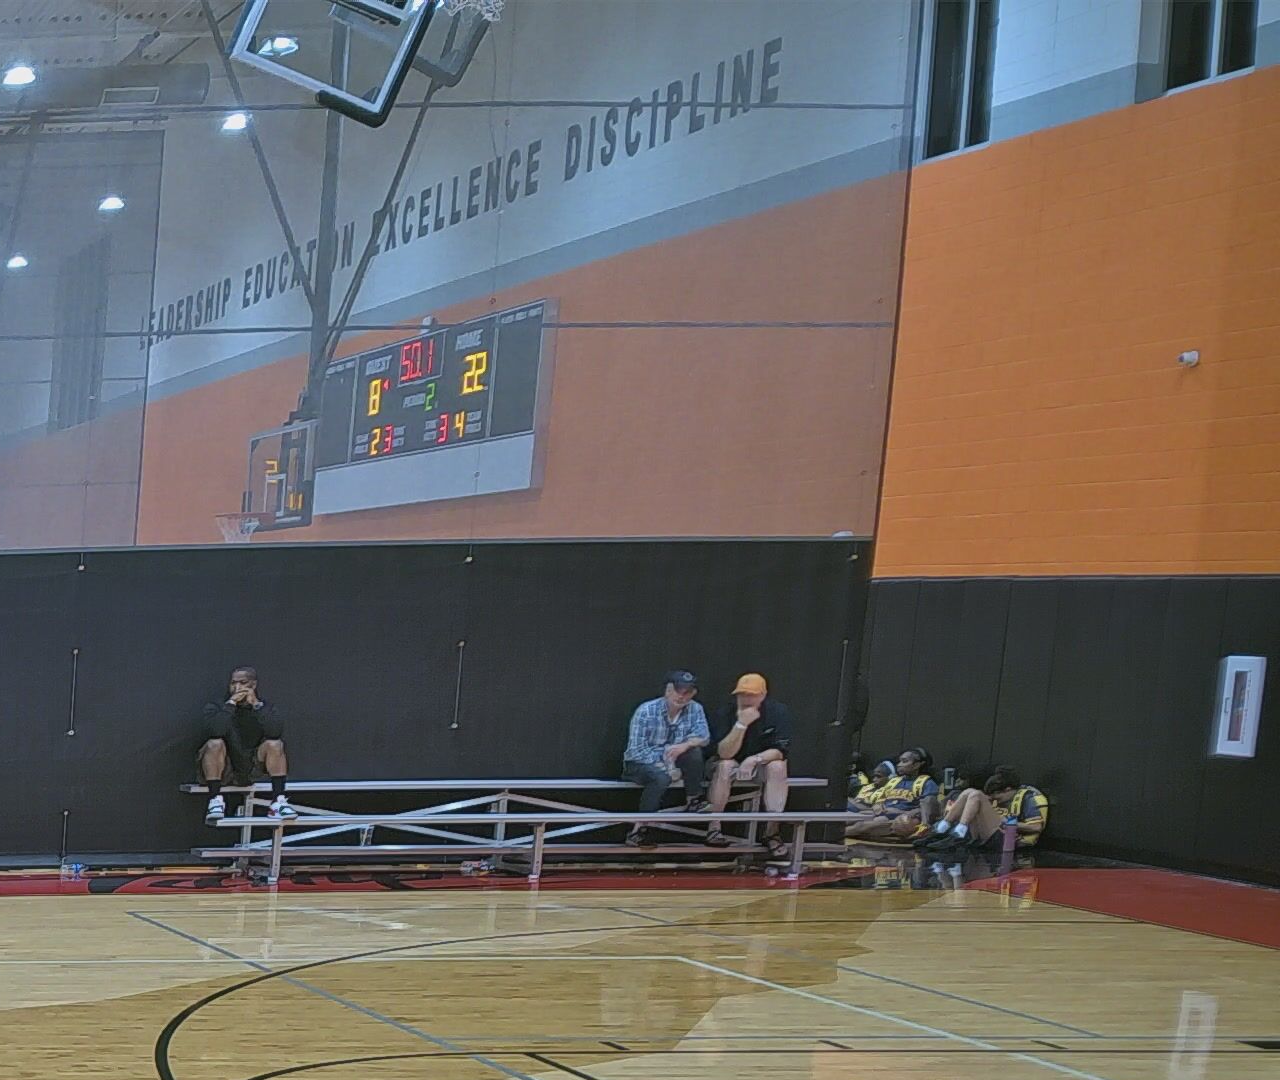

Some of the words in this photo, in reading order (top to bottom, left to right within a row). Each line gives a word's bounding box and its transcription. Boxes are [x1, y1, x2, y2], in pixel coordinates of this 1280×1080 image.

[241, 220, 355, 309] EDUCATN
[563, 36, 783, 182] DISCIPLINE
[462, 351, 487, 395] 22
[367, 378, 382, 417] 8
[424, 382, 436, 411] 2
[383, 424, 393, 453] 3
[437, 413, 449, 443] 3
[454, 410, 465, 438] 4
[369, 427, 381, 455] 2
